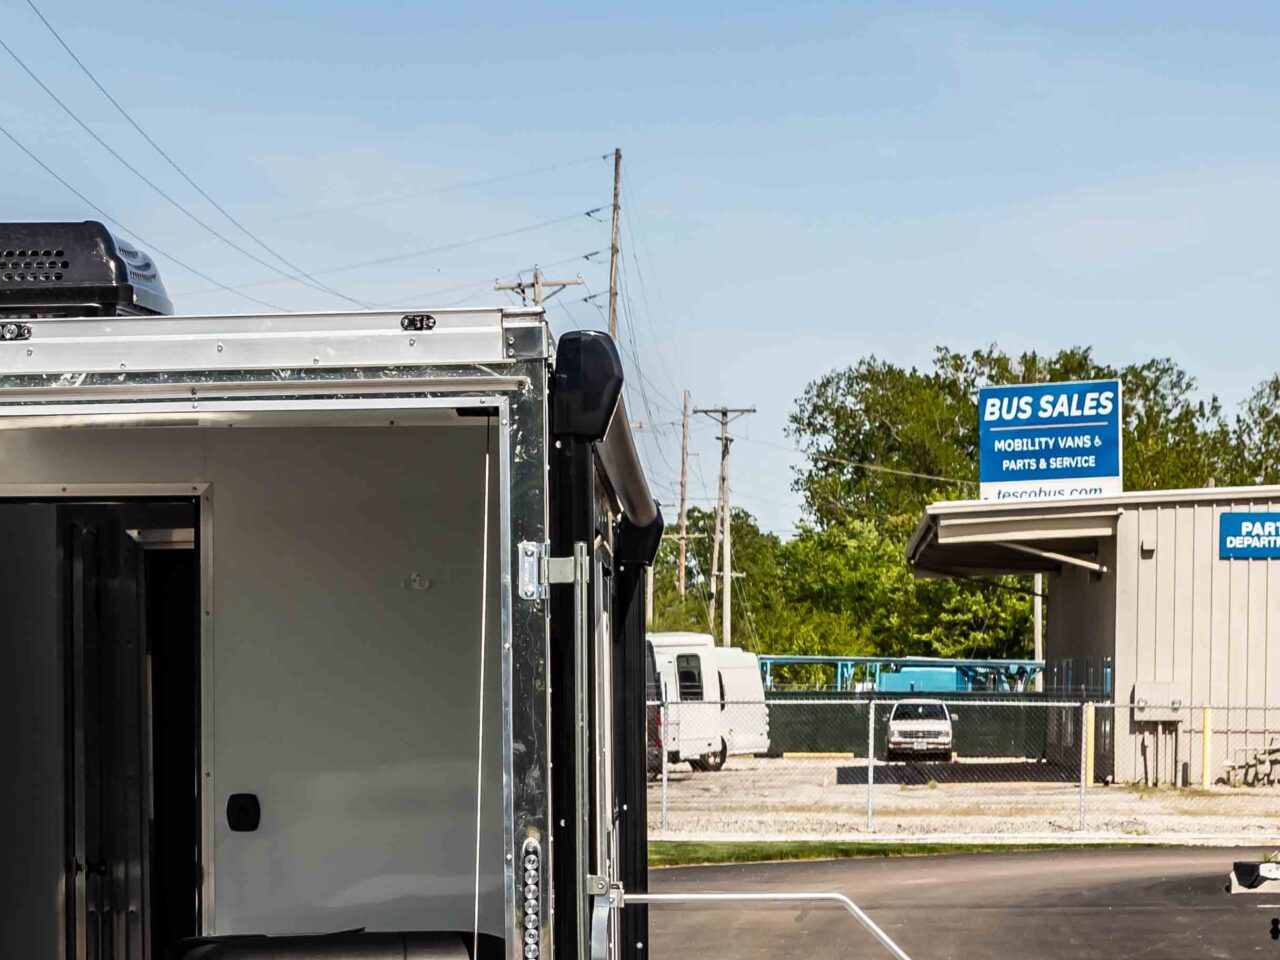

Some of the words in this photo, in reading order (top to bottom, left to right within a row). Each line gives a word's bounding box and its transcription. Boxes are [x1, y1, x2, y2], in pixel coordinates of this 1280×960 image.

[984, 396, 1033, 421] BUS
[1038, 391, 1114, 418] SALES
[994, 437, 1055, 452] MOBILITY
[1058, 435, 1091, 449] VANS
[1002, 459, 1037, 471] PARTS
[1039, 458, 1047, 469] &
[1049, 456, 1095, 469] SERVICE
[997, 487, 1102, 499] tescobuscom
